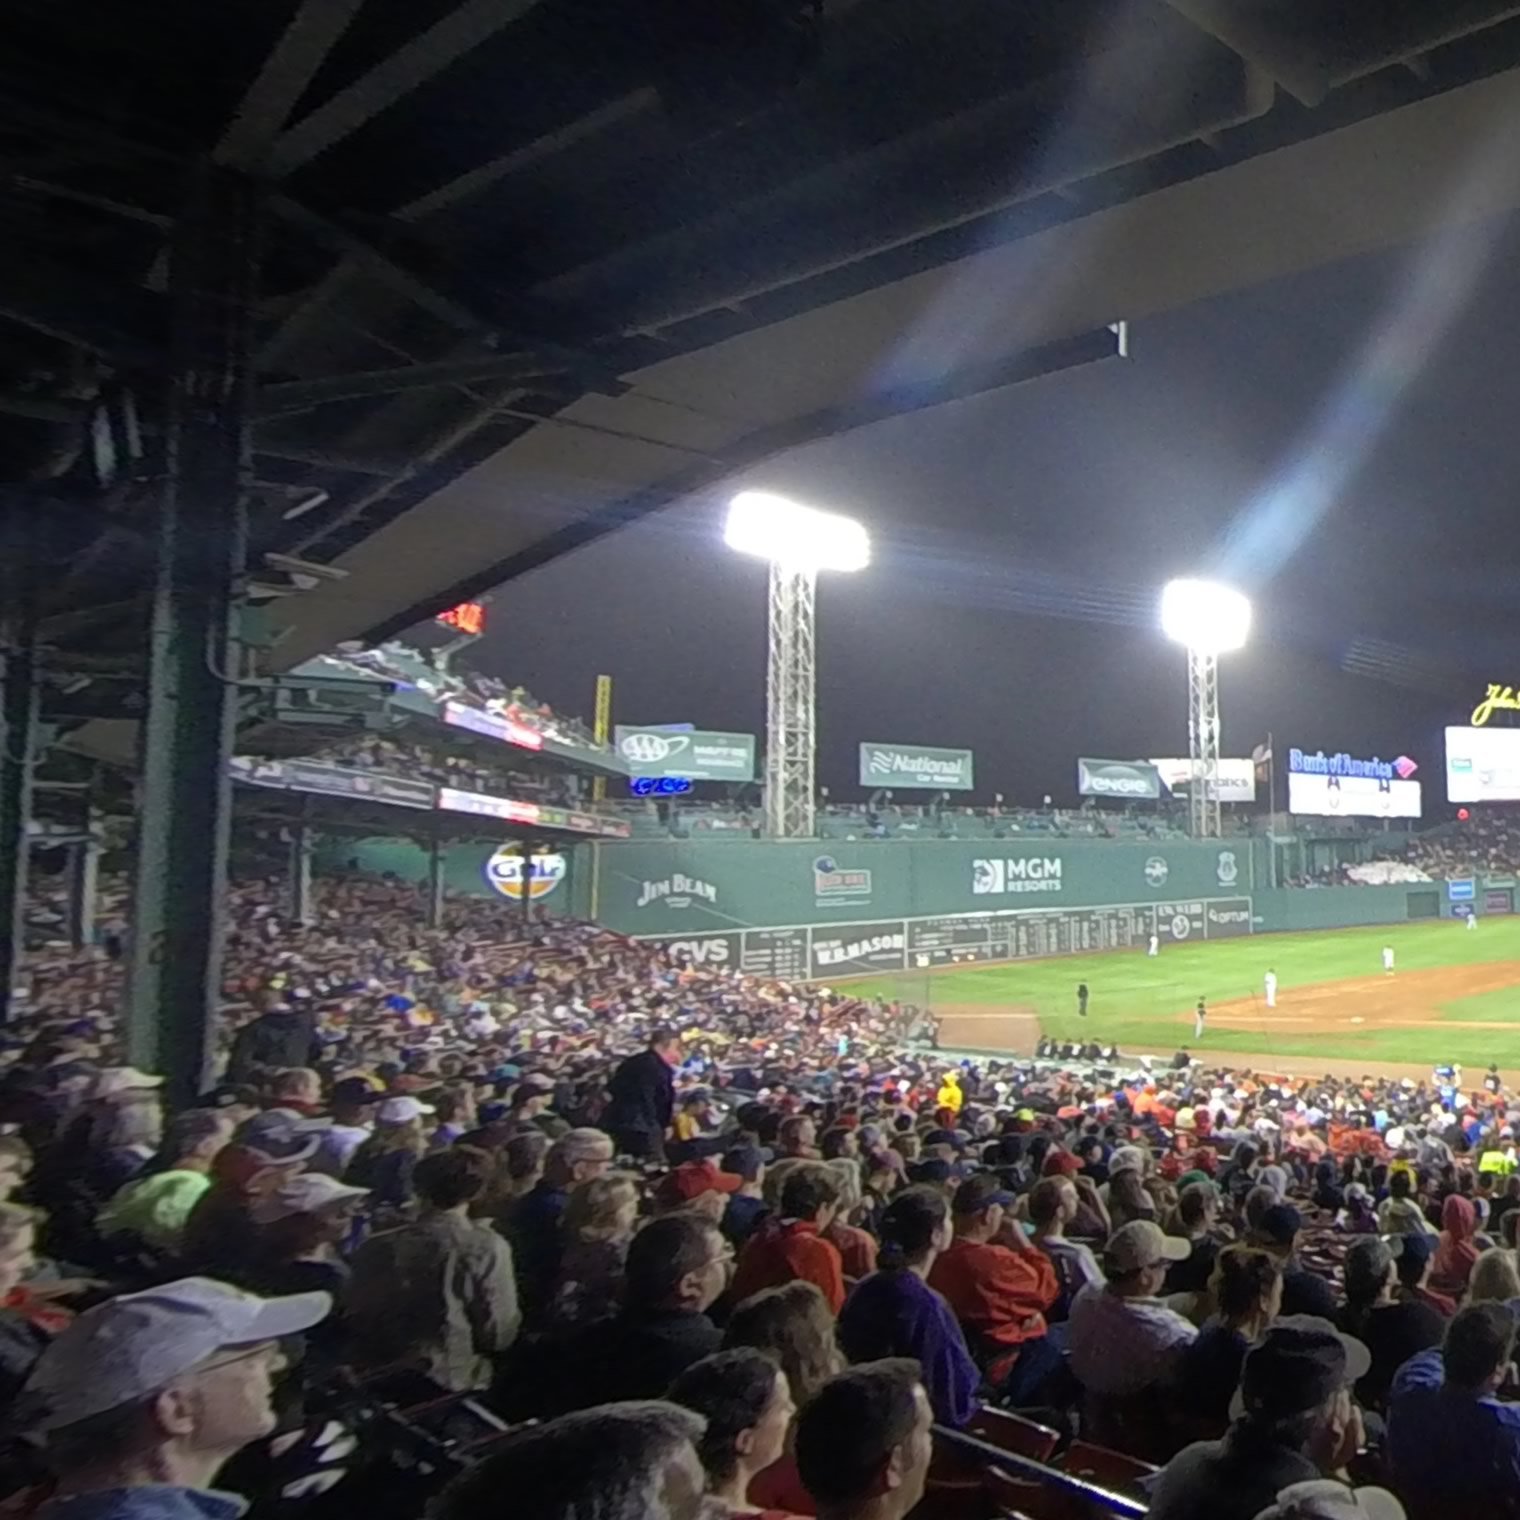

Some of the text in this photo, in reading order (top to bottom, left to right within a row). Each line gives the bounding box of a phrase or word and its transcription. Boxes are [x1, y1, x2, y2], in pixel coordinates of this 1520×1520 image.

[892, 754, 963, 775] National
[1289, 747, 1328, 774] Bank
[1342, 754, 1393, 779] America
[1008, 858, 1062, 880] MGM
[637, 880, 671, 908] JIM
[672, 873, 717, 903] BEAM
[1007, 879, 1062, 892] RESORTS
[668, 938, 730, 963] CVS
